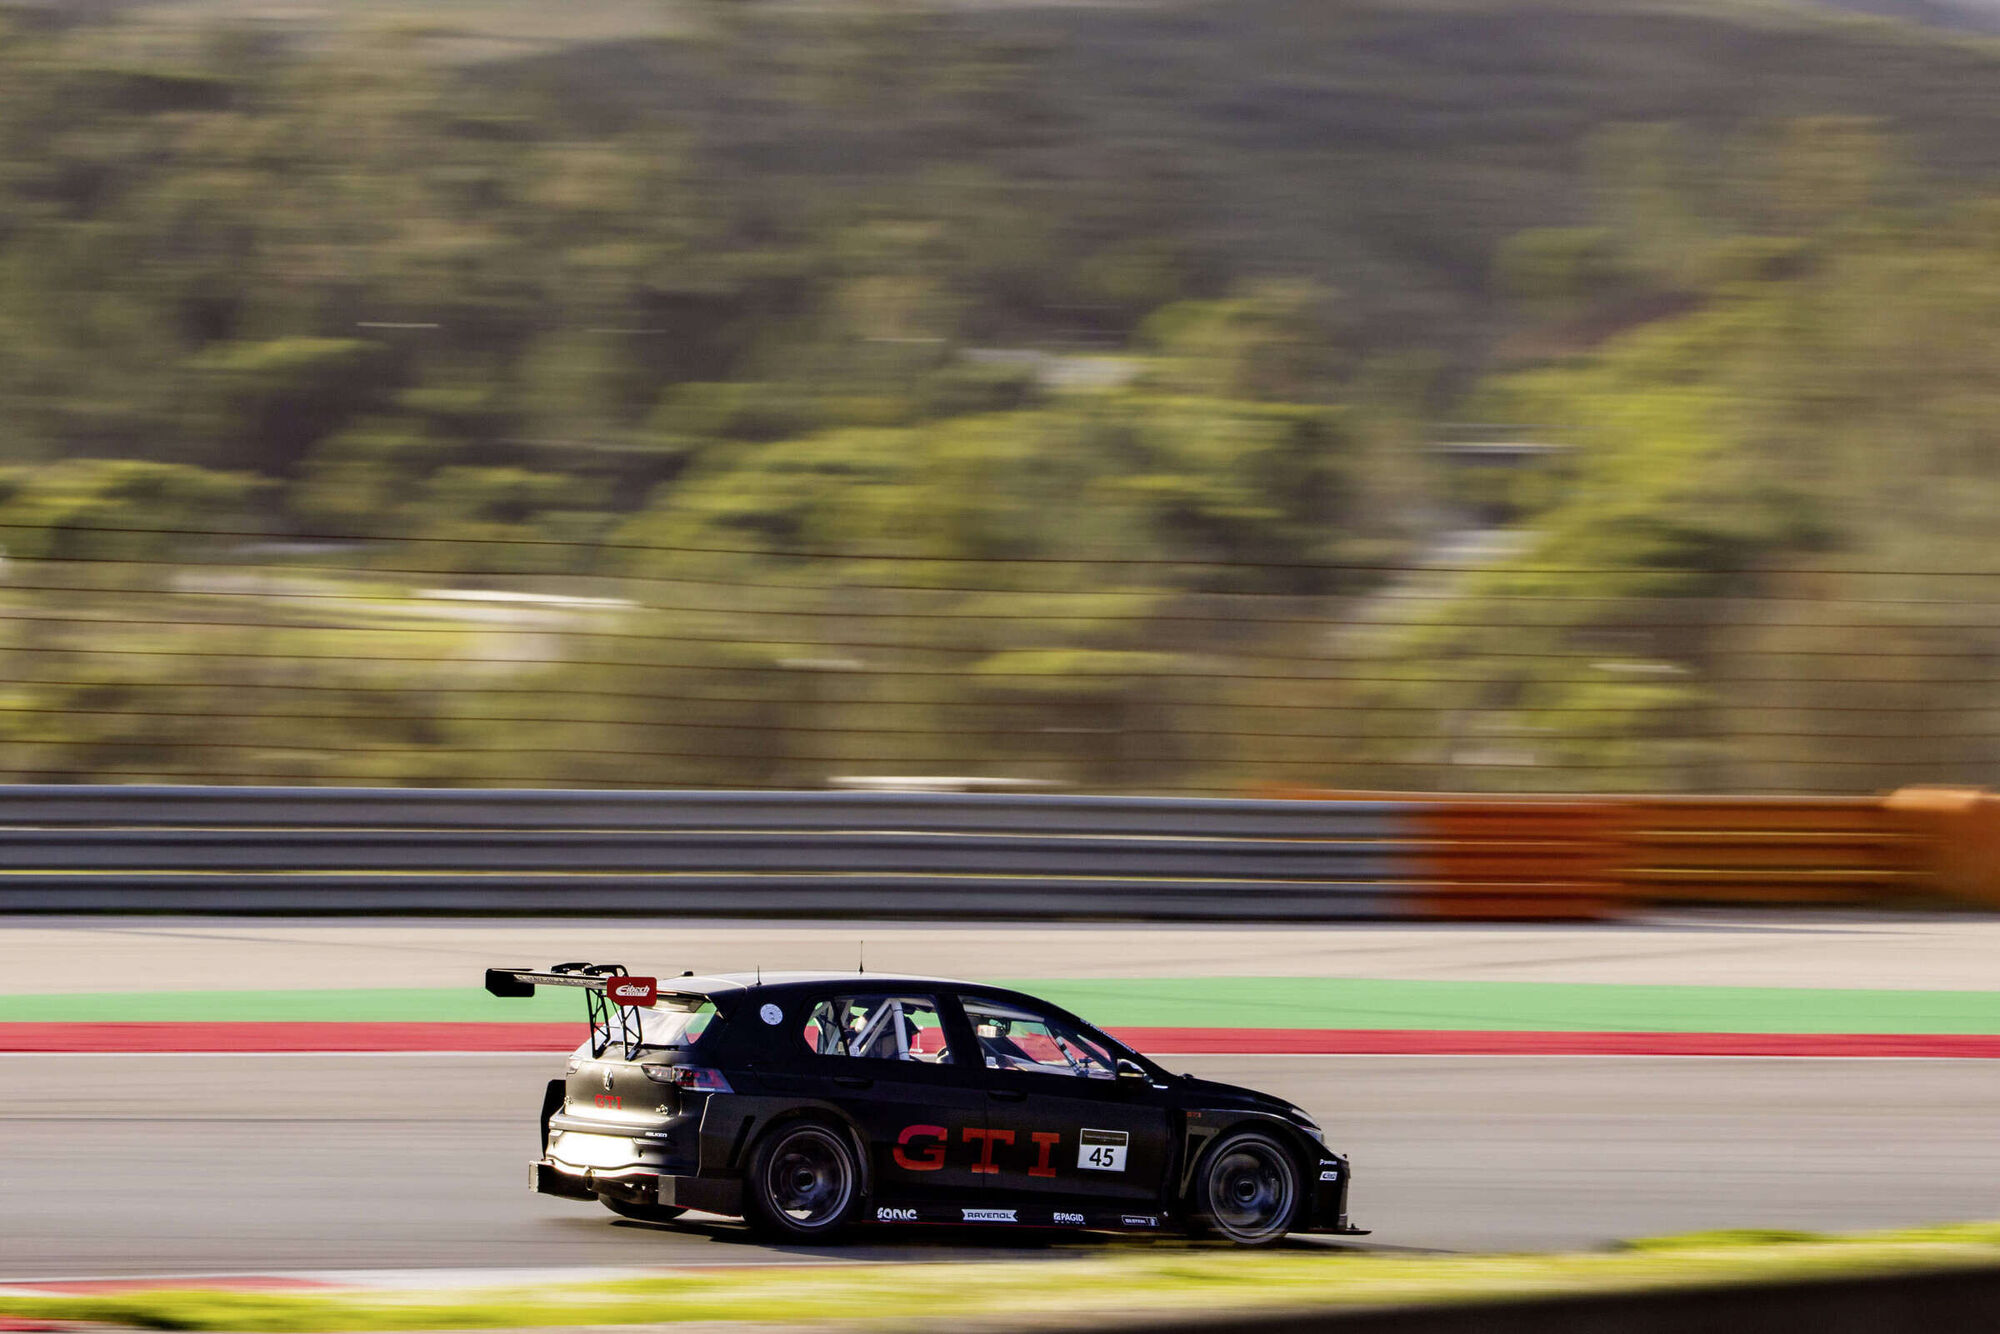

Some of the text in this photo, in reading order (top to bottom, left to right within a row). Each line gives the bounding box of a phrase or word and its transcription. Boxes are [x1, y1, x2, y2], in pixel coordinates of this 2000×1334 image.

[594, 1093, 622, 1111] GTI
[893, 1124, 1060, 1178] GTI
[1088, 1147, 1114, 1167] 45
[1060, 1212, 1084, 1222] PAGID
